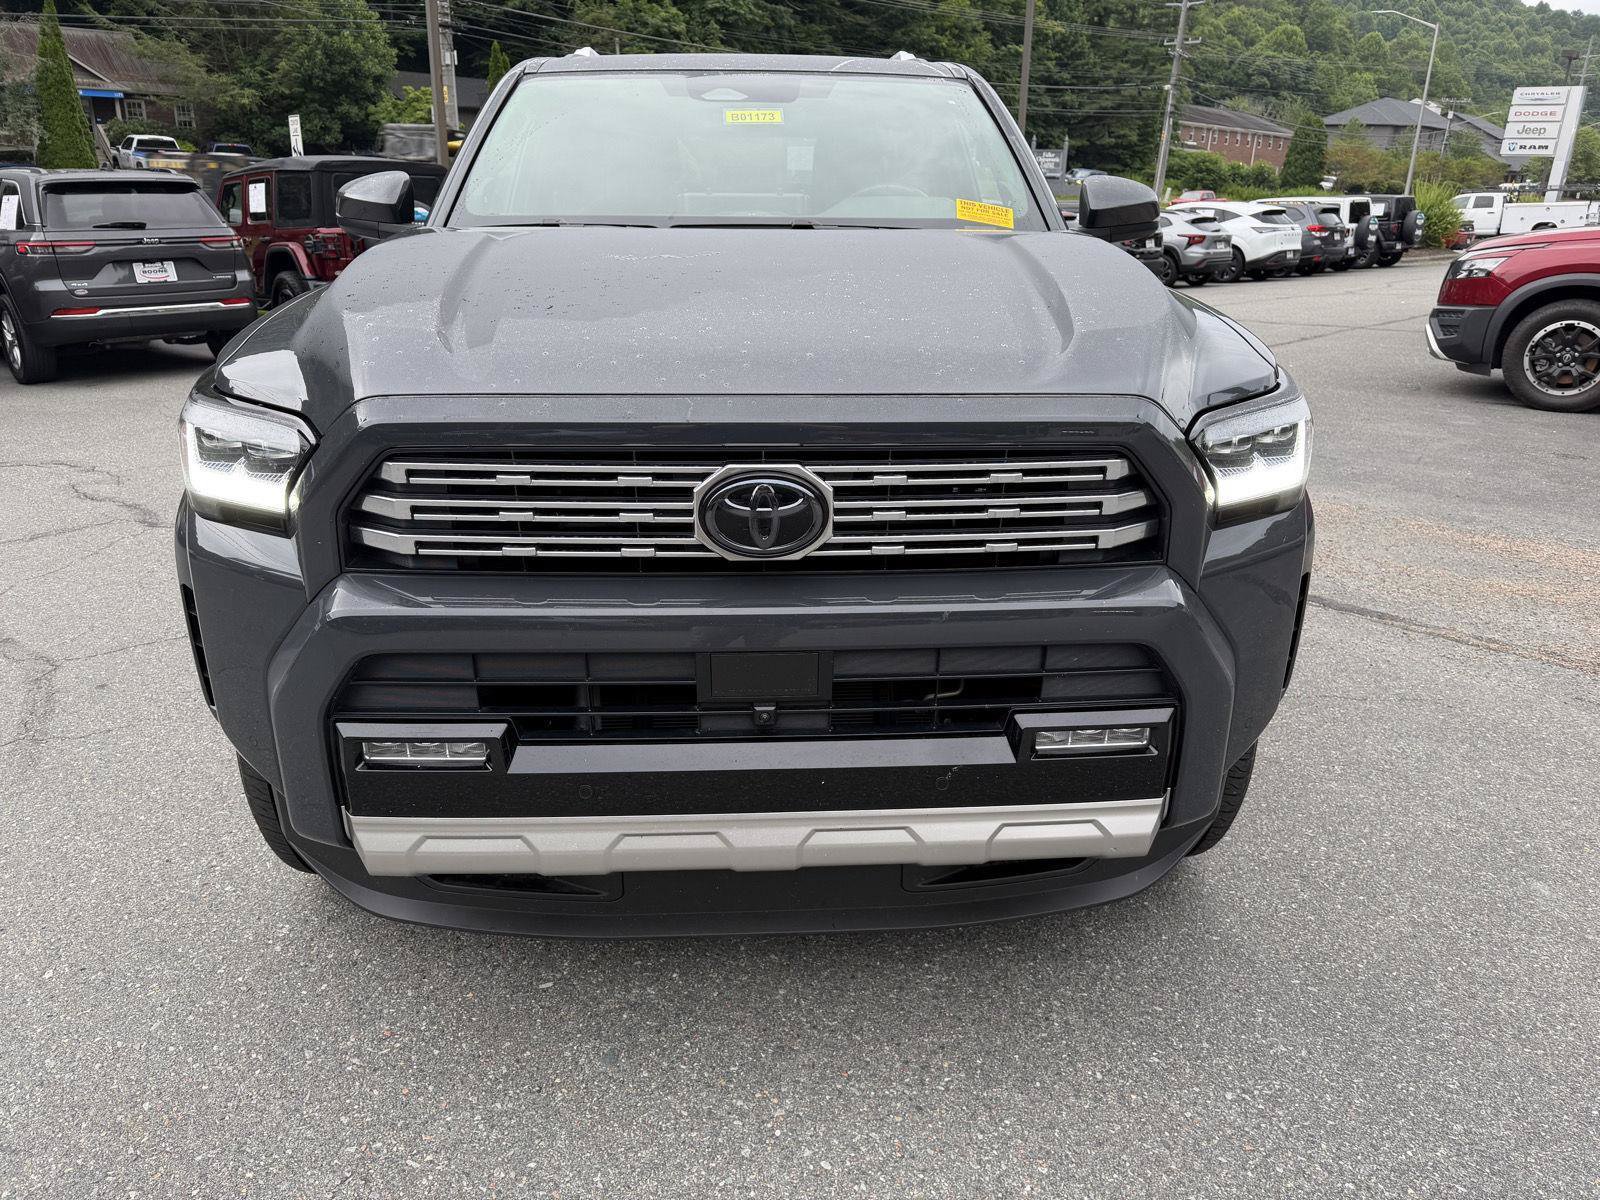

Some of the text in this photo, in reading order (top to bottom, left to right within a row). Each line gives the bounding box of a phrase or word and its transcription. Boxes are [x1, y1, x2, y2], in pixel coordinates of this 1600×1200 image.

[731, 112, 776, 121] B01173
[1517, 125, 1546, 136] Jeep
[978, 204, 1009, 214] VEHICLE
